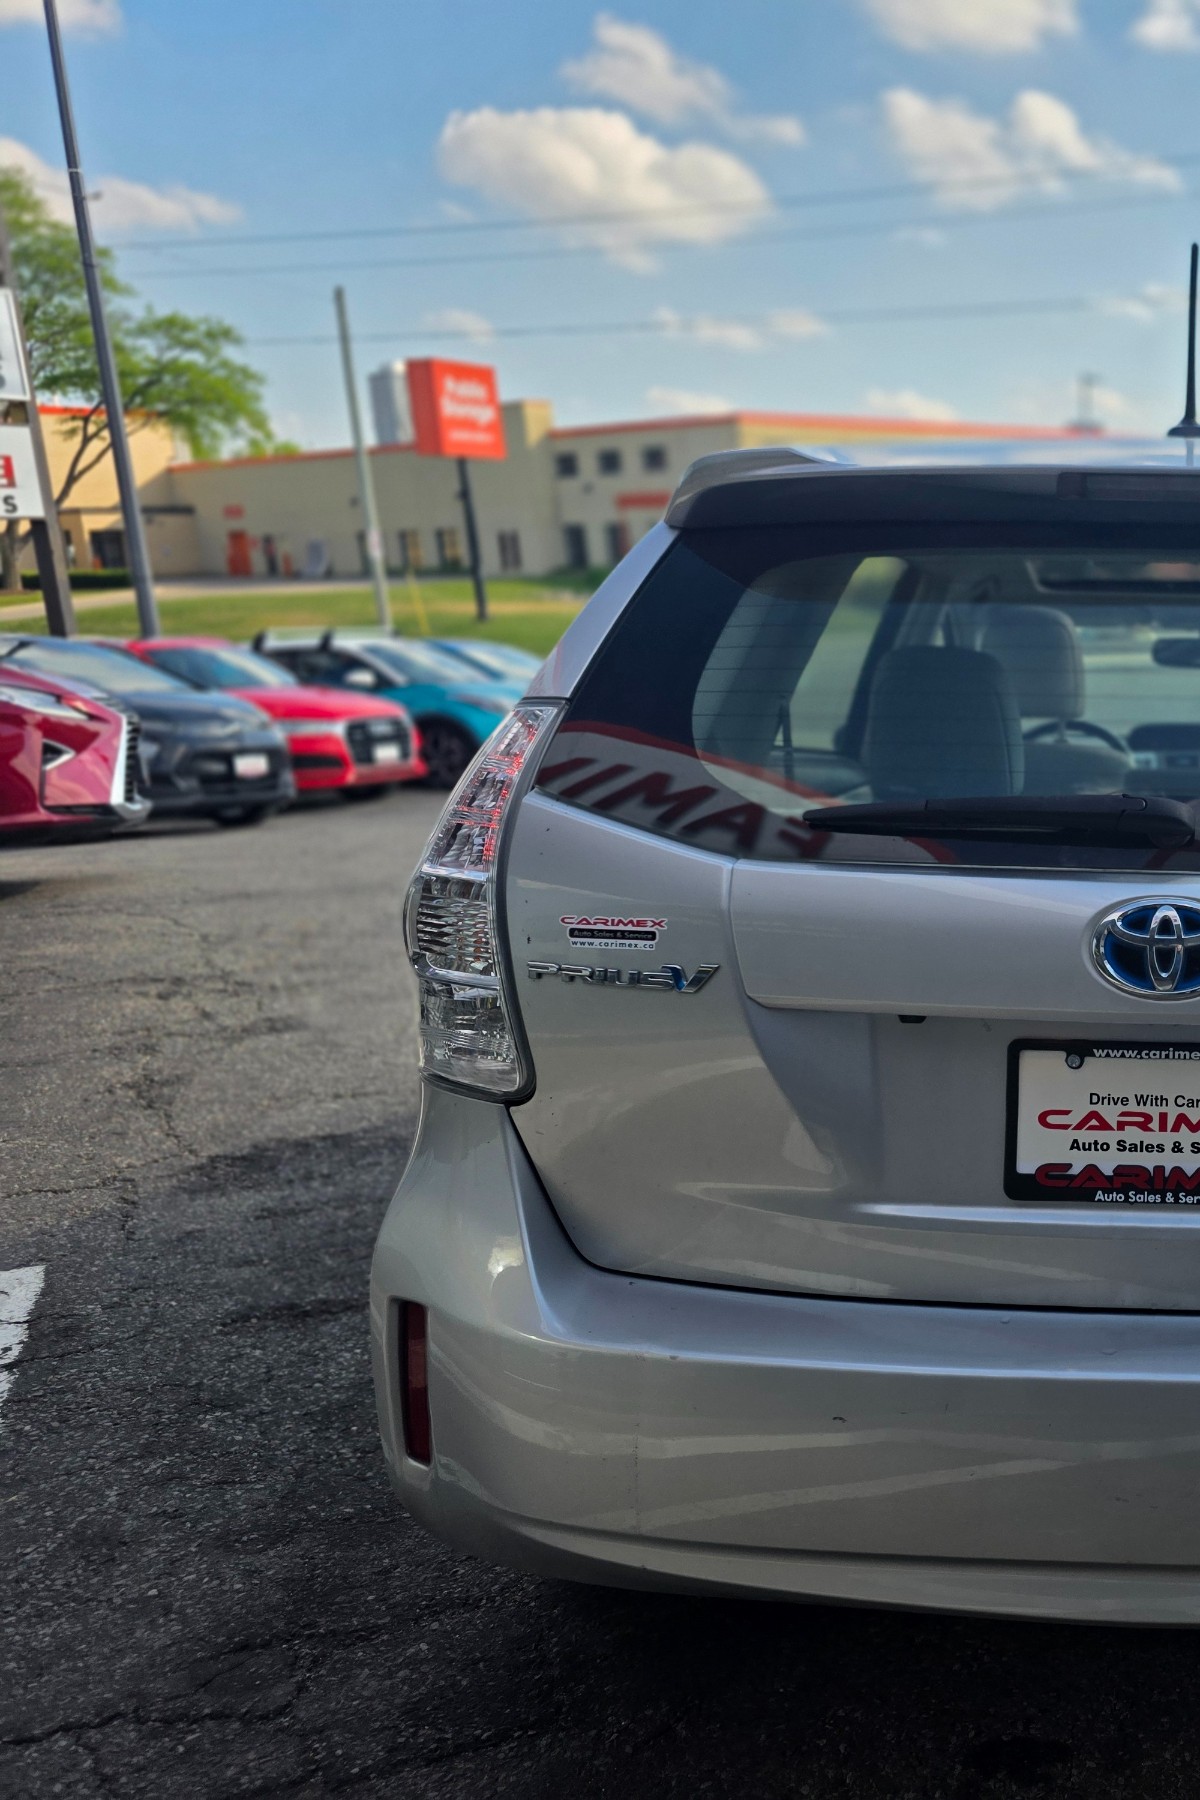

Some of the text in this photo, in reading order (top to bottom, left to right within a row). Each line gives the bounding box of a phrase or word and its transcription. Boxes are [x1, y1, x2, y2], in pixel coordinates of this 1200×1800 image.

[560, 916, 667, 928] CARIMEX
[573, 930, 653, 940] Auto Sales & Service
[571, 940, 655, 950] www.carimex.ca
[527, 961, 675, 990] PRIUS
[1089, 1092, 1130, 1107] Drive
[1134, 1093, 1169, 1108] With
[1069, 1138, 1111, 1153] Auto
[1116, 1139, 1166, 1154] Sales
[1171, 1140, 1185, 1155] &
[1094, 1190, 1124, 1203] Auto
[1128, 1191, 1161, 1204] Sales
[1165, 1192, 1175, 1205] &
